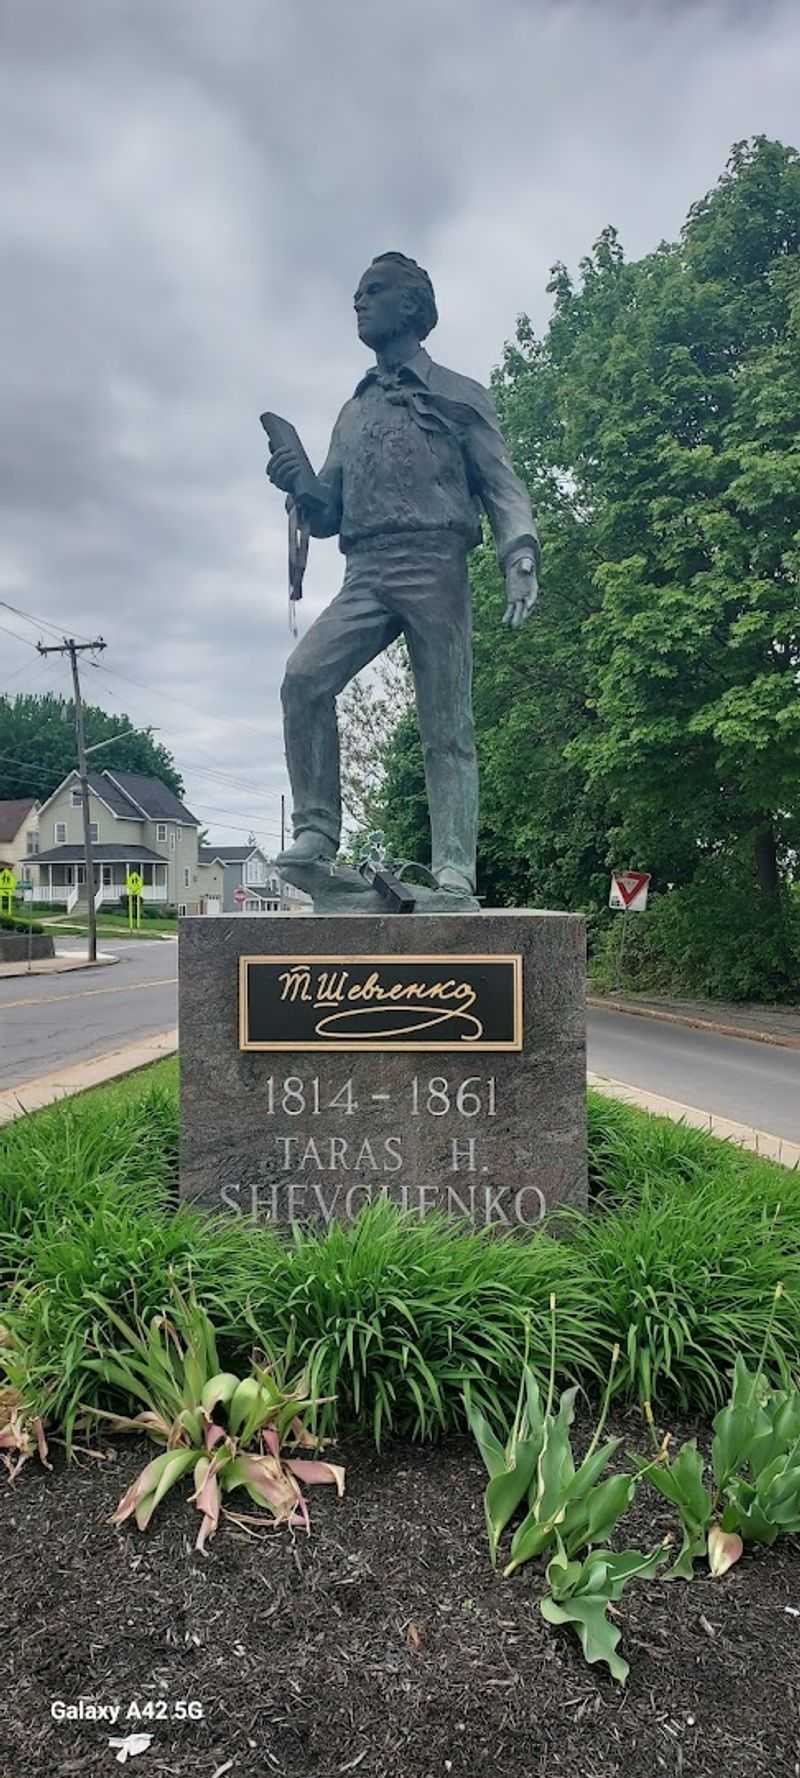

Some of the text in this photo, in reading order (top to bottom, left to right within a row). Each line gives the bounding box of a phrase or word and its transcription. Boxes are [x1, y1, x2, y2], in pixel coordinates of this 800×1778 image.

[266, 1076, 358, 1116] 1814
[410, 1076, 498, 1116] 1861
[275, 1137, 489, 1173] TARAS H.
